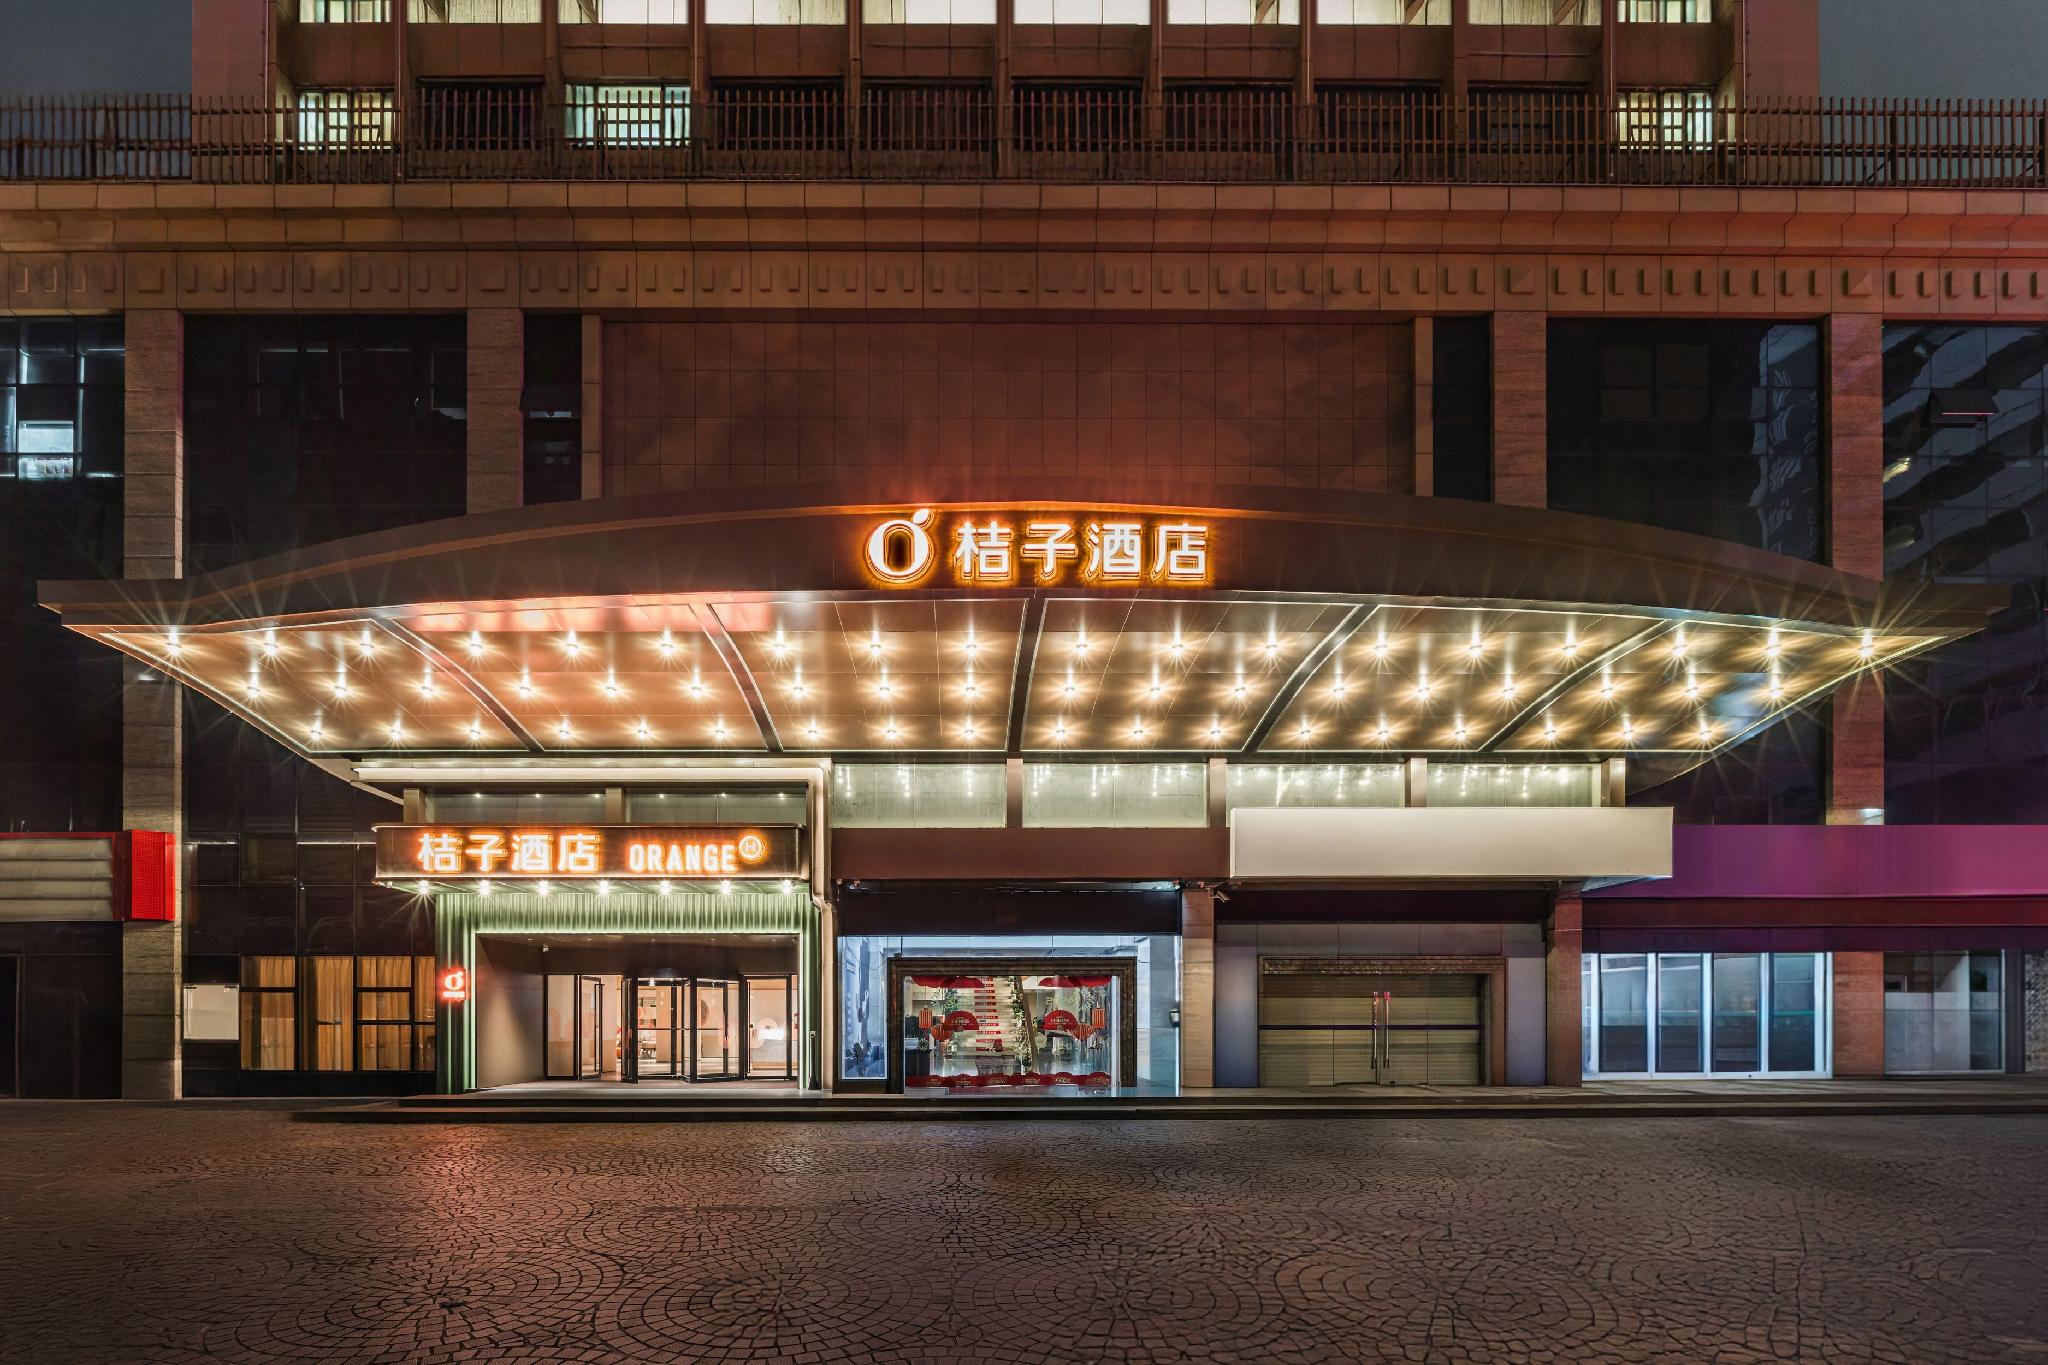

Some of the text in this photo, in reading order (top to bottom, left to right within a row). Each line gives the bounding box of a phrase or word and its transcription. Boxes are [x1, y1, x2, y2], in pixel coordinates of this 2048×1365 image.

[954, 521, 1209, 579] 桔子酒店
[417, 833, 600, 872] 桔子酒店
[629, 843, 737, 872] ORANGE
